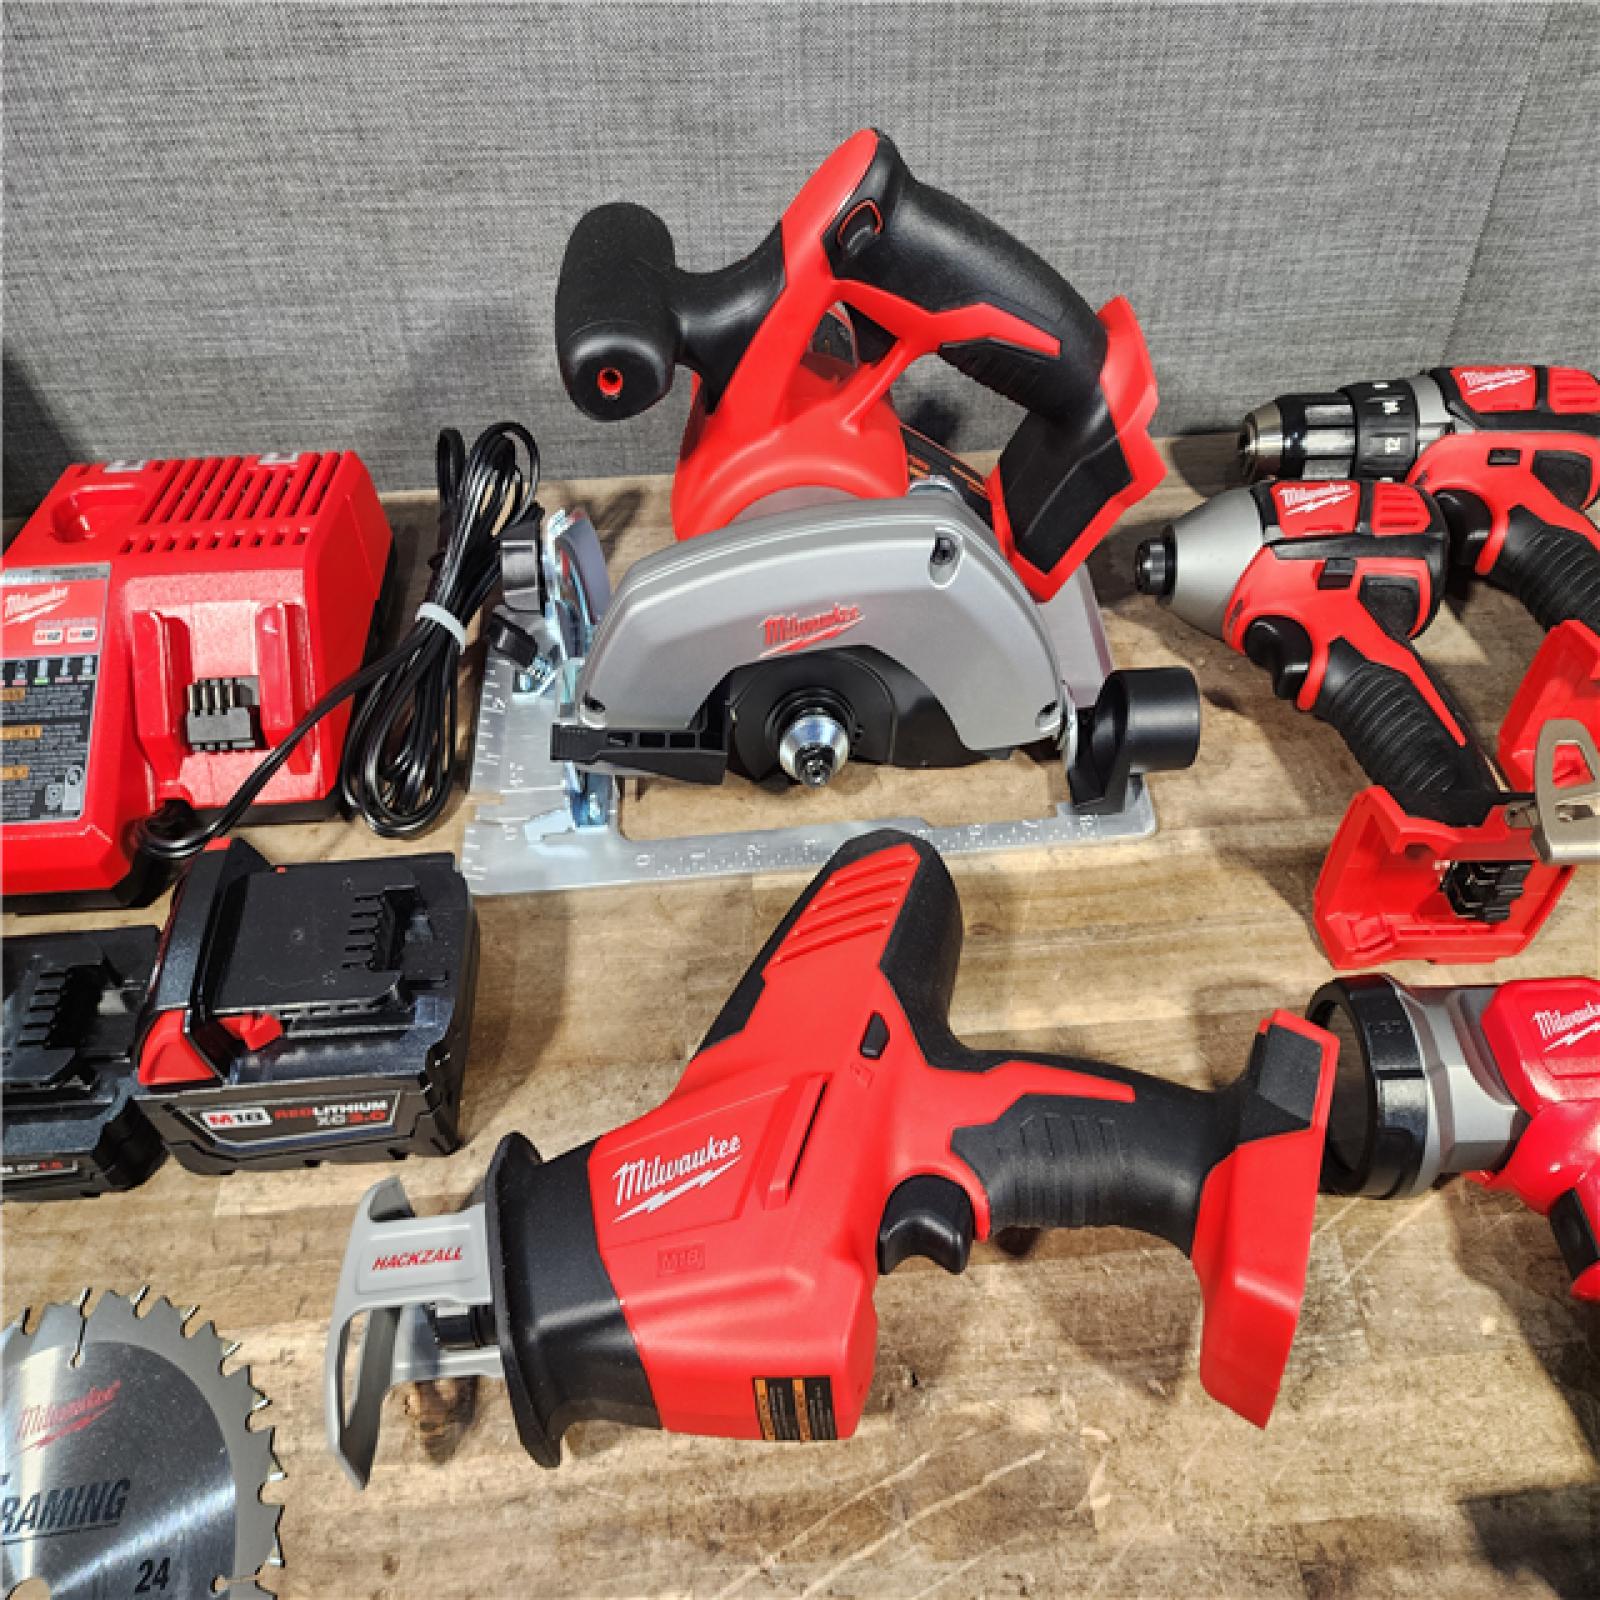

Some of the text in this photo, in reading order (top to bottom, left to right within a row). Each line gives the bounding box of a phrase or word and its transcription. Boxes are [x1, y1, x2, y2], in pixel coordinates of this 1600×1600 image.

[1278, 482, 1351, 509] Milwaukee
[763, 601, 859, 646] Milwaukee
[612, 1134, 741, 1206] Milwaukee
[372, 1246, 463, 1271] HACKZALL
[135, 1557, 170, 1593] 24
